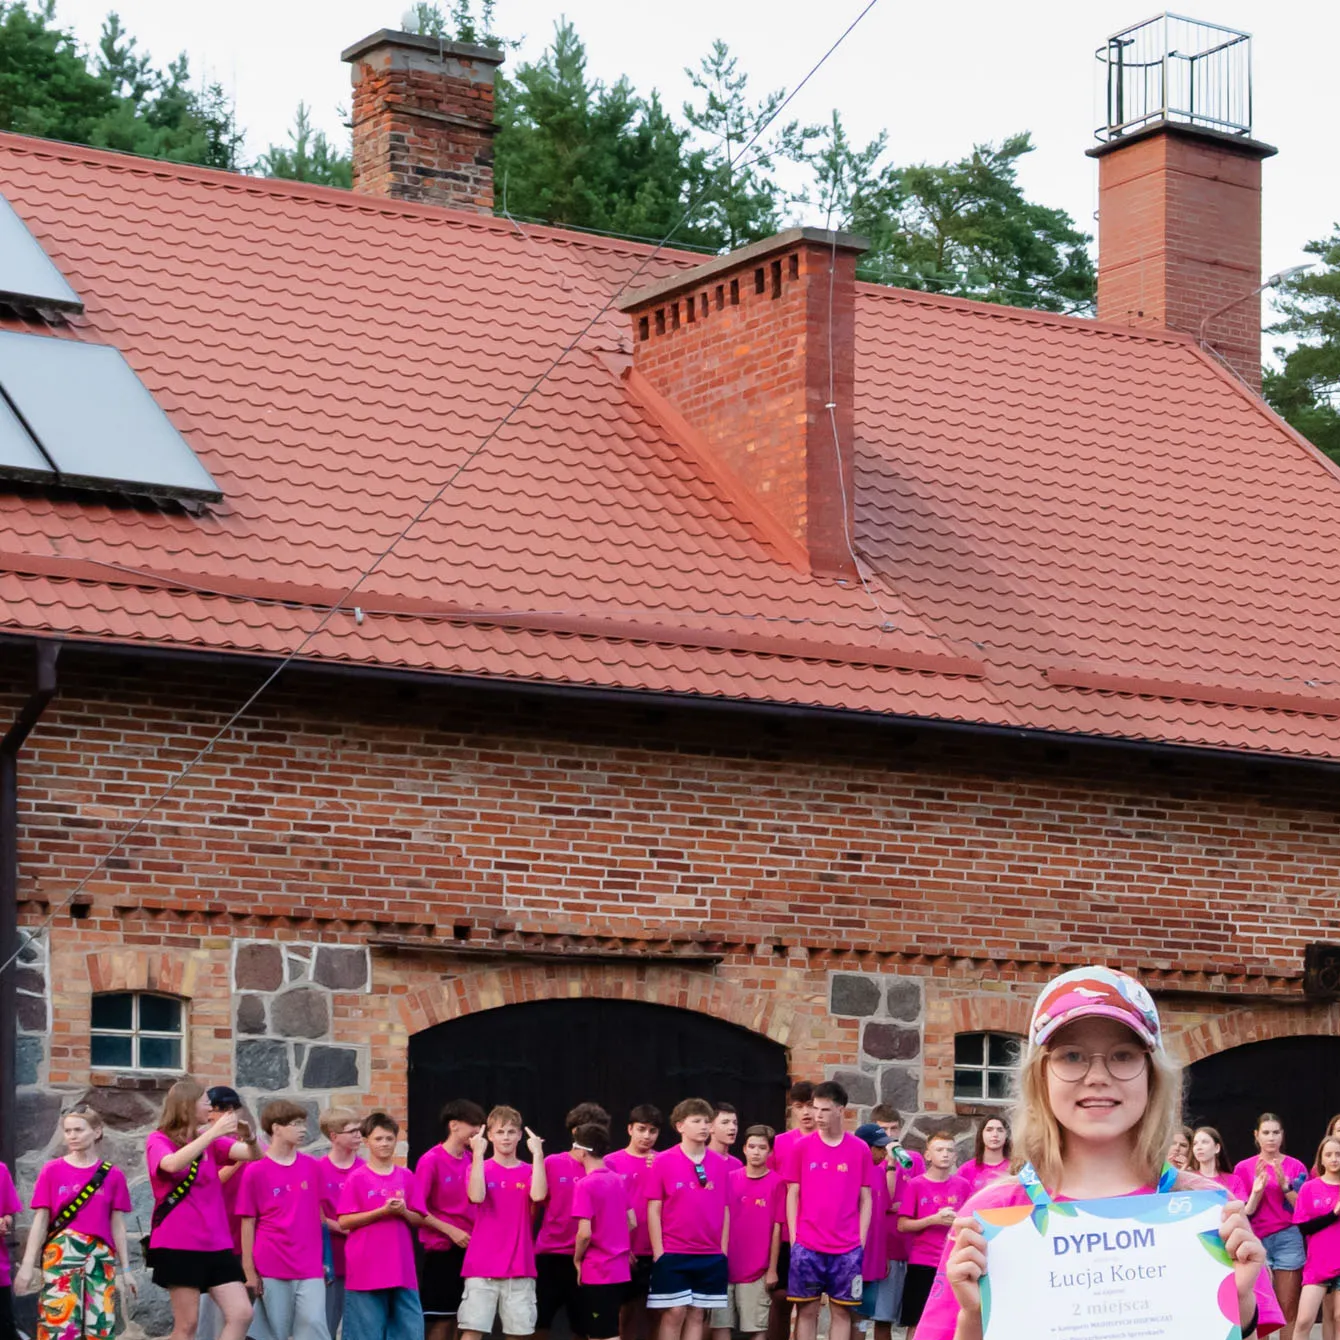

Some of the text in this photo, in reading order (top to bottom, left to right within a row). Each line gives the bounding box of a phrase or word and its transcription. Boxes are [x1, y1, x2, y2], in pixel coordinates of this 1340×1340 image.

[1053, 1228, 1156, 1256] DYPLOM
[1049, 1263, 1167, 1290] Łucja Koter
[1072, 1298, 1150, 1317] 2 miejsca
